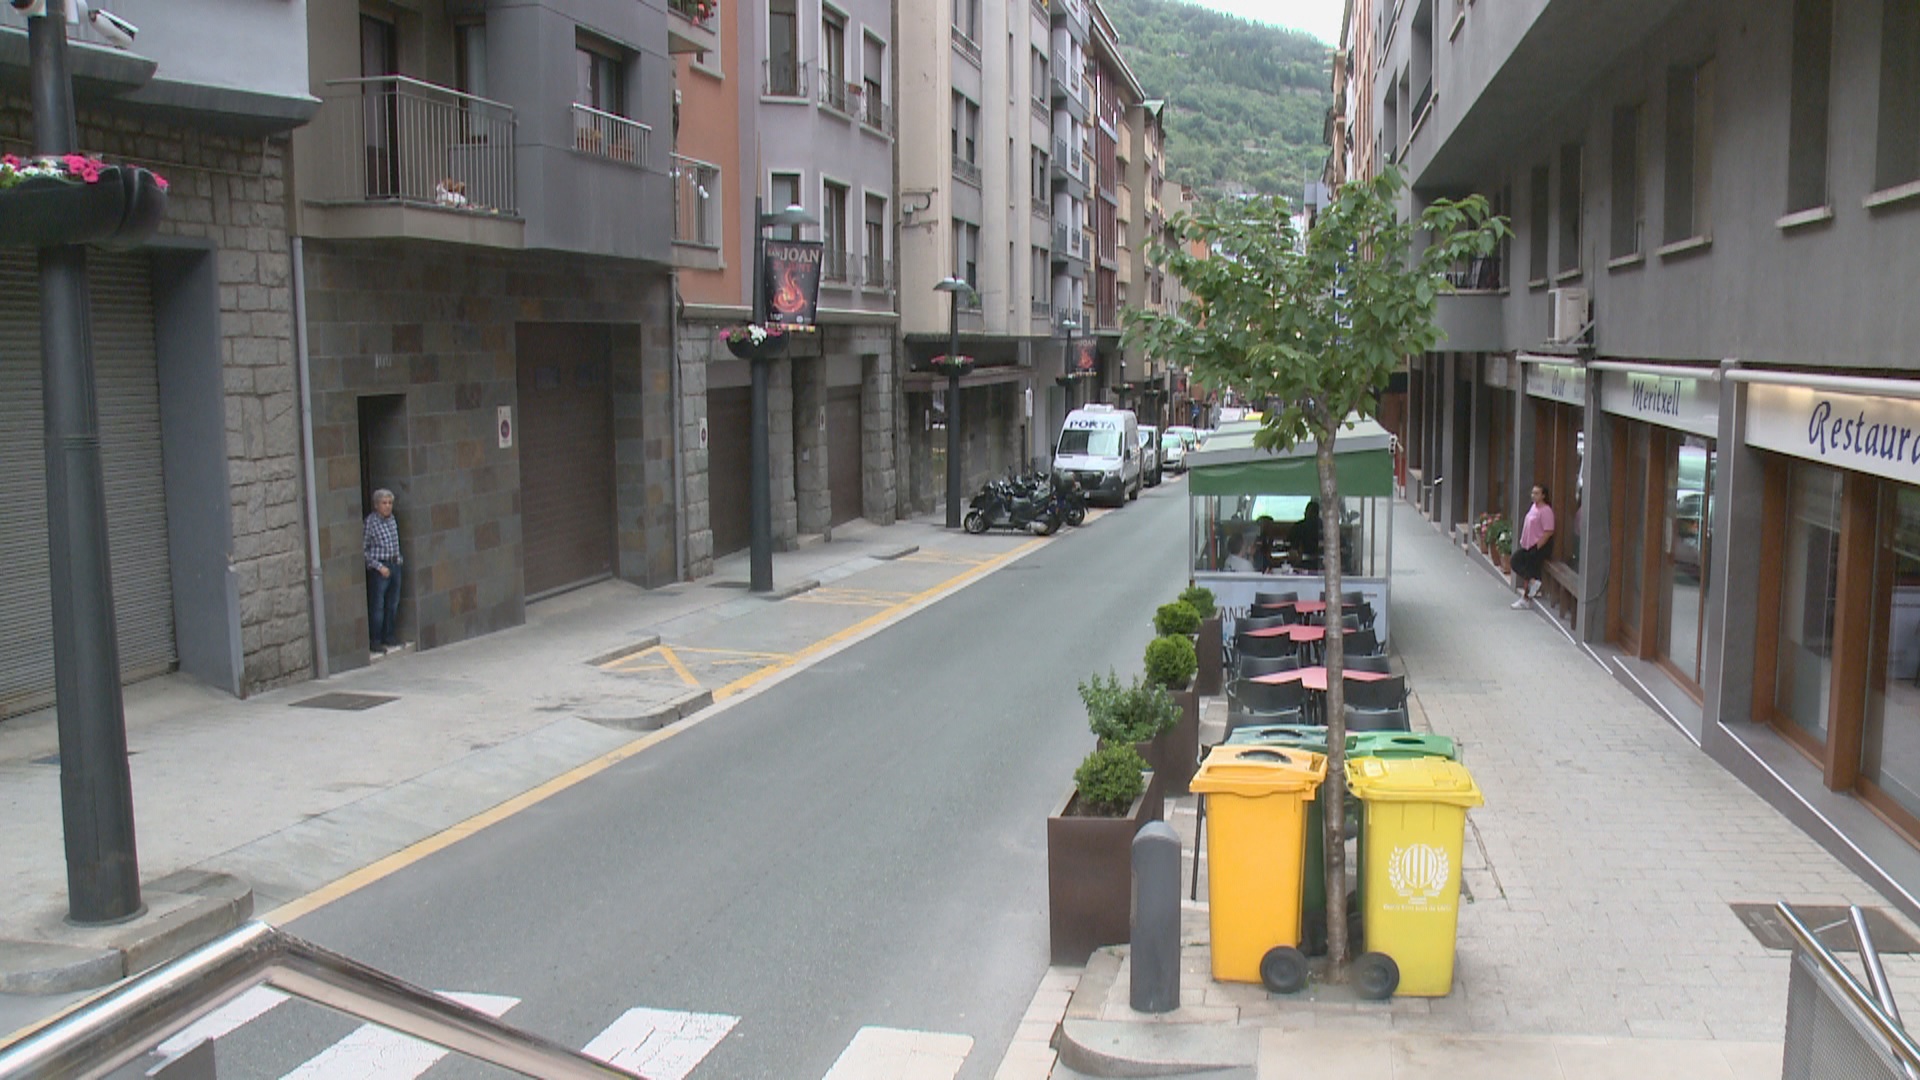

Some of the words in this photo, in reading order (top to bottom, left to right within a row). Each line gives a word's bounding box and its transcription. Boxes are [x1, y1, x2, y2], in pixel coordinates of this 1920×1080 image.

[780, 247, 820, 265] JOAN
[1632, 378, 1681, 417] Meritxell
[1069, 420, 1116, 430] PORTA
